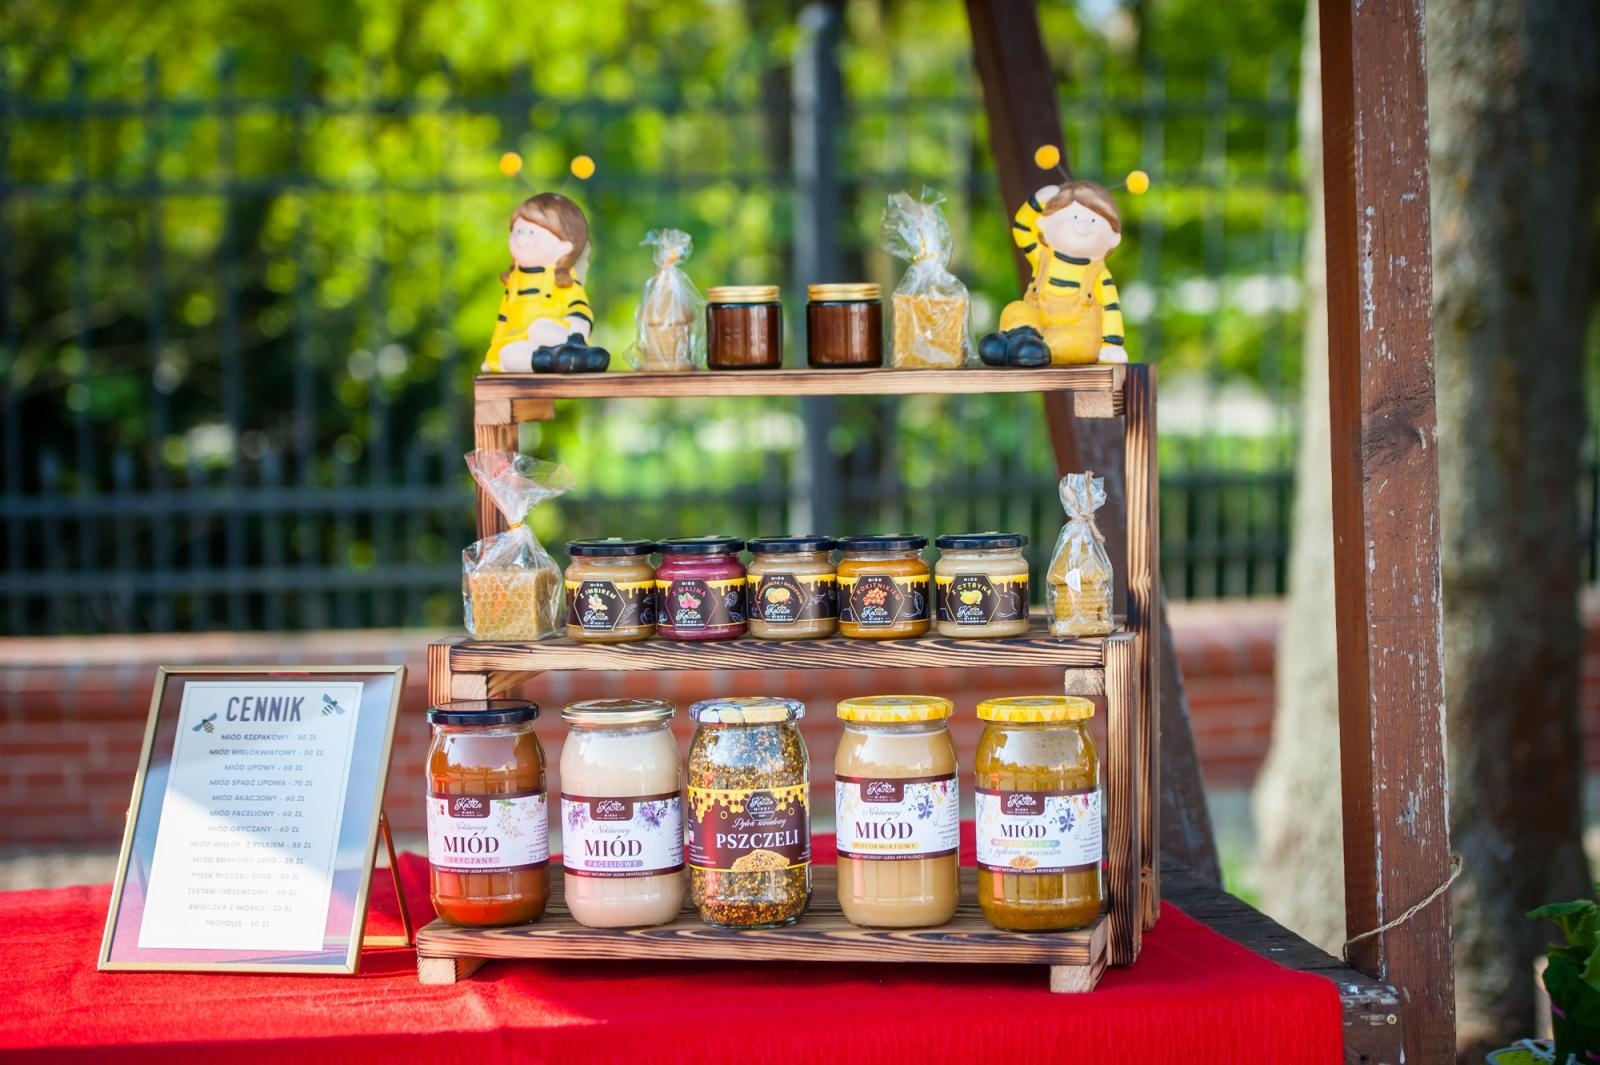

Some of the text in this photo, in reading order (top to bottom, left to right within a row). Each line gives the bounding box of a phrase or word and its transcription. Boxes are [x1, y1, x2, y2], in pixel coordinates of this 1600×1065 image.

[585, 587, 617, 599] IMBIREM
[226, 696, 305, 722] CENNIK
[209, 779, 230, 787] MIÓD
[257, 779, 286, 787] LIPOWA
[856, 818, 913, 839] MIÓD
[1000, 821, 1046, 838] MIÓD
[444, 833, 499, 853] MIÓD
[585, 835, 642, 857] MIÓD
[716, 829, 798, 849] PSZCZELI
